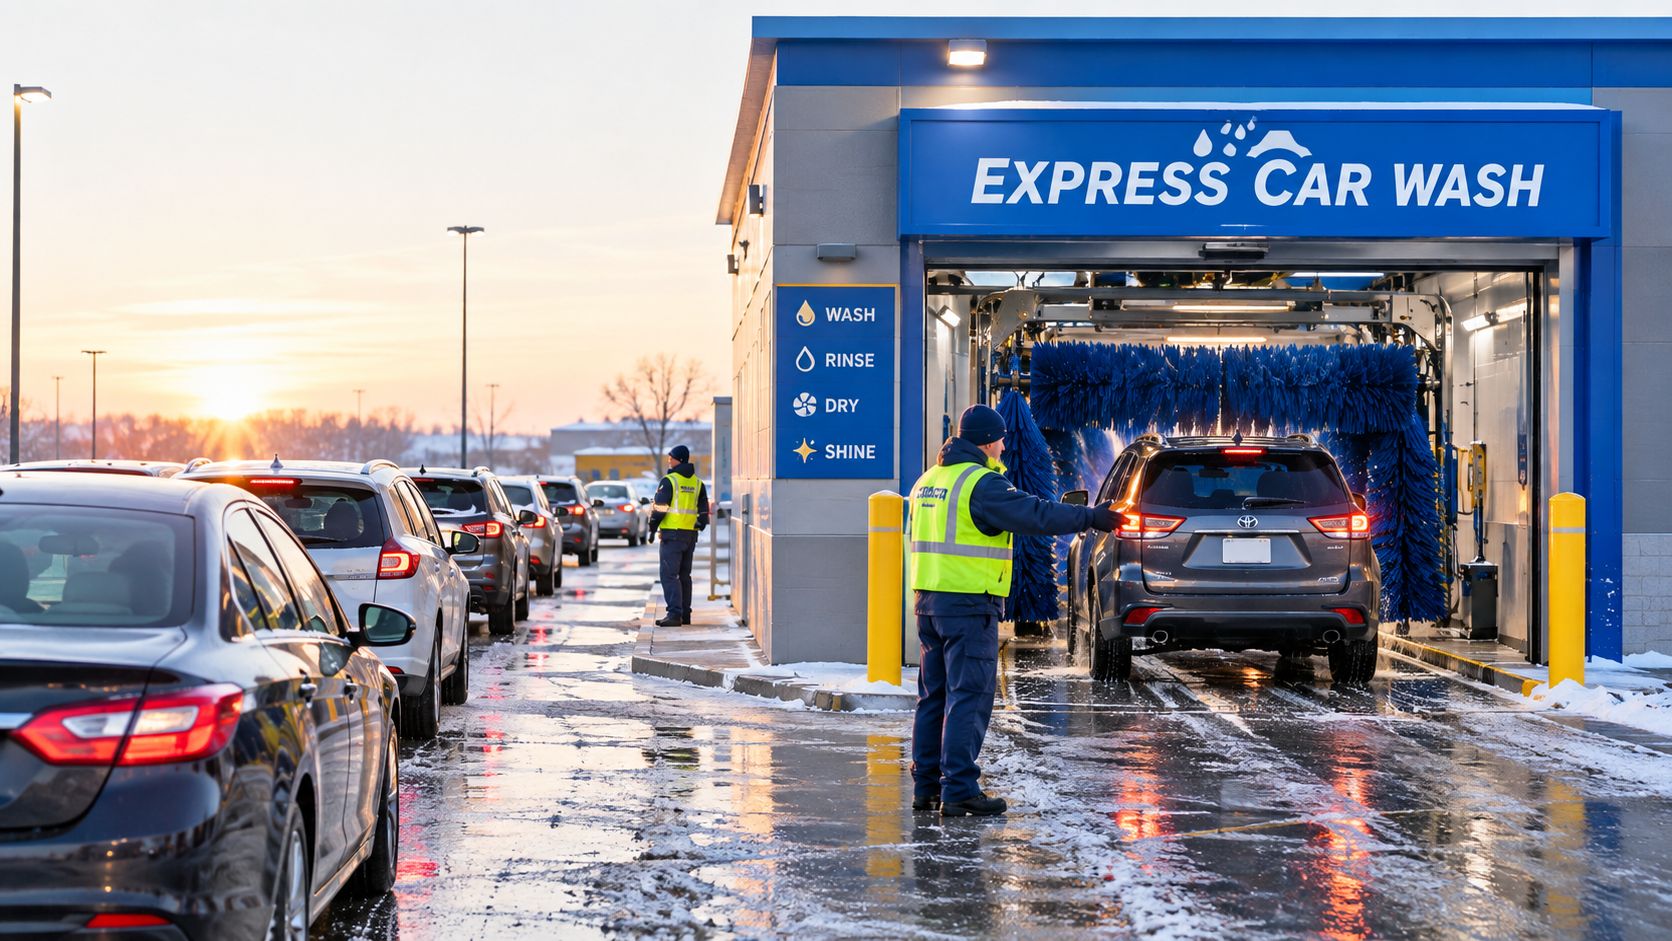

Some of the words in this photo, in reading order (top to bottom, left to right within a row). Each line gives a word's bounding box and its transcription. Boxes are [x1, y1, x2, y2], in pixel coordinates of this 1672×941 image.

[971, 157, 1230, 206] EXPRESS
[1254, 158, 1372, 207] CAR
[1394, 163, 1545, 208] WASH
[825, 307, 876, 322] WASH
[825, 353, 875, 368] RINSE
[825, 398, 859, 413] DRY
[825, 444, 876, 459] SHINE
